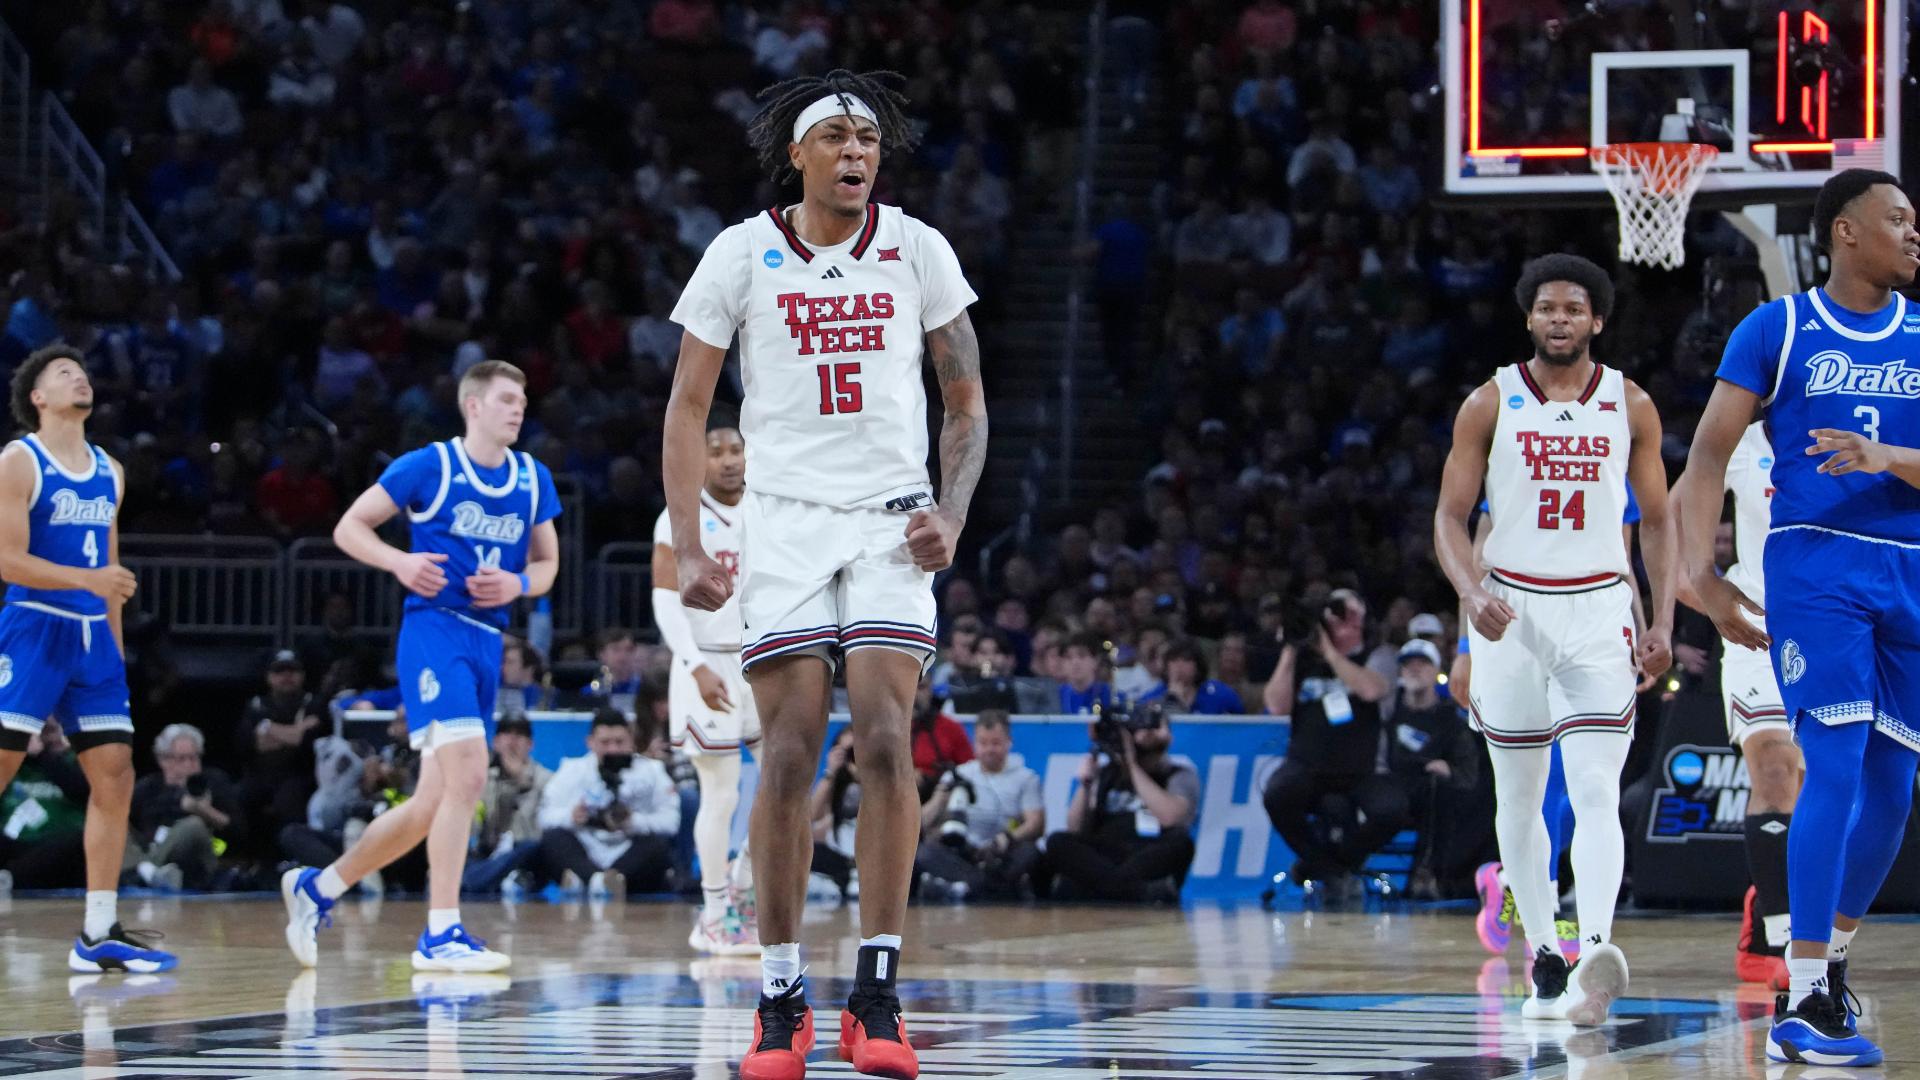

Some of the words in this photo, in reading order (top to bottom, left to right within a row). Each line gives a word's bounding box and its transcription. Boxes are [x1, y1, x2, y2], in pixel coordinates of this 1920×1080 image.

[777, 292, 895, 326] TEXAS
[790, 322, 886, 356] TECH
[817, 362, 862, 416] 15
[1804, 349, 1920, 399] Drake
[1853, 405, 1880, 443] 3
[1516, 431, 1611, 458] TEXAS
[1525, 454, 1601, 482] TECH
[48, 488, 117, 527] Drake
[449, 500, 525, 545] Drake
[1537, 489, 1586, 531] 24
[82, 530, 99, 568] 4
